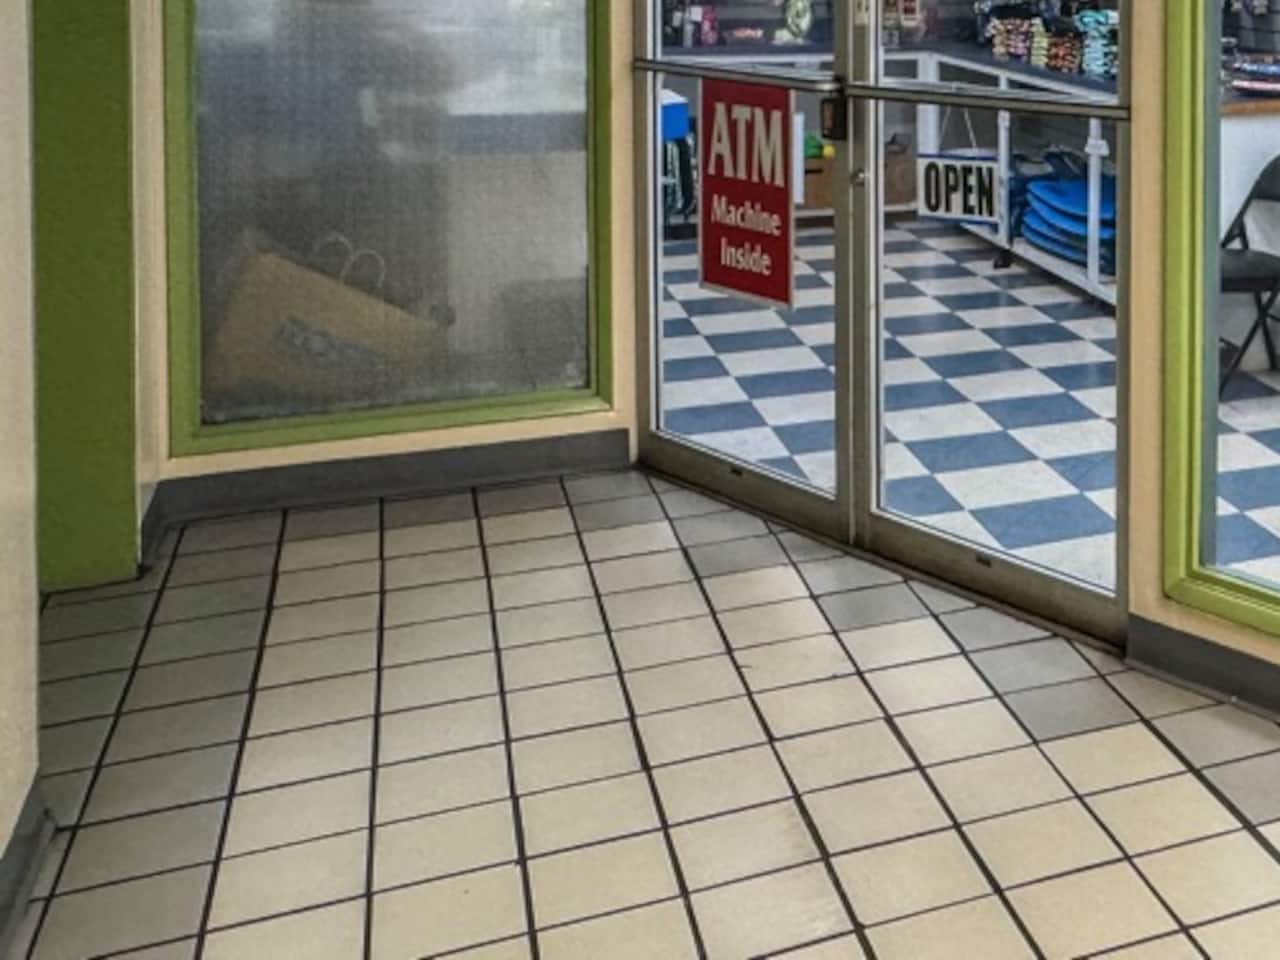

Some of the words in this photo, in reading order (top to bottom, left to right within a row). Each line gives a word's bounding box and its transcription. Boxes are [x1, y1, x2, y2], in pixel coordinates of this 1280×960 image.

[707, 101, 785, 188] ATM
[711, 193, 782, 236] Machine
[925, 161, 994, 218] OPEN
[720, 236, 772, 276] Inside
